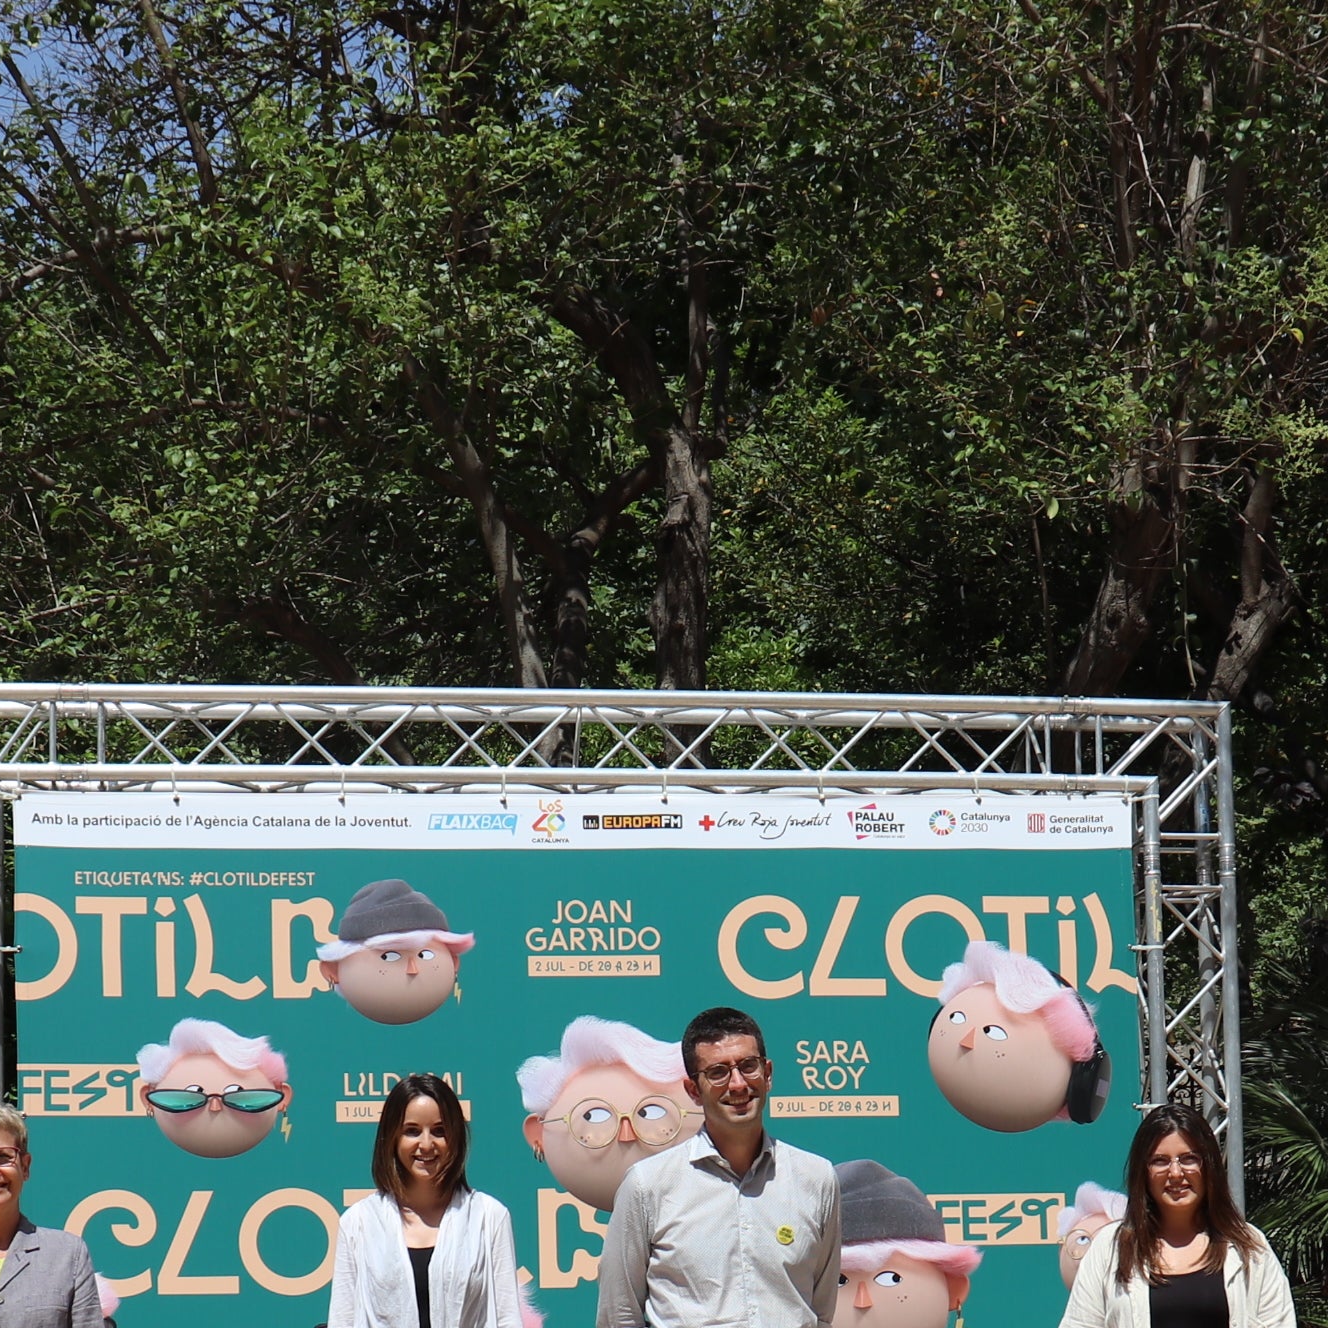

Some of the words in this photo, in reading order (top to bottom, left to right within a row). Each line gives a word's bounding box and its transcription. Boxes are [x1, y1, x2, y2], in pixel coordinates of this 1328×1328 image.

[31, 812, 63, 825] Amb
[67, 813, 79, 826] la
[82, 813, 162, 829] participació
[165, 815, 182, 827] de
[252, 815, 311, 828] Catalana
[314, 815, 331, 828] de
[335, 815, 346, 827] la
[349, 815, 412, 828] Joventut.
[855, 811, 895, 822] PALAU
[960, 812, 1011, 823] Catalunya
[1049, 814, 1104, 824] Generalitat
[855, 823, 906, 833] ROBERT
[960, 823, 989, 833] 2030
[1049, 824, 1063, 834] de
[1065, 824, 1114, 835] Catalunya
[188, 871, 316, 887] #CLOTILDEFEST
[552, 899, 632, 924] JOAN
[525, 926, 661, 952] GARRIDO
[535, 961, 542, 972] 2
[578, 960, 594, 972] DE
[598, 960, 612, 972] 20
[615, 960, 623, 972] A
[626, 960, 640, 972] 23
[796, 1040, 870, 1065] SARA
[802, 1066, 866, 1090] ROY
[17, 1069, 141, 1112] FEST
[776, 1101, 784, 1112] 9
[819, 1100, 834, 1112] DE
[837, 1101, 852, 1112] 20
[854, 1101, 862, 1112] A
[865, 1100, 879, 1112] 23
